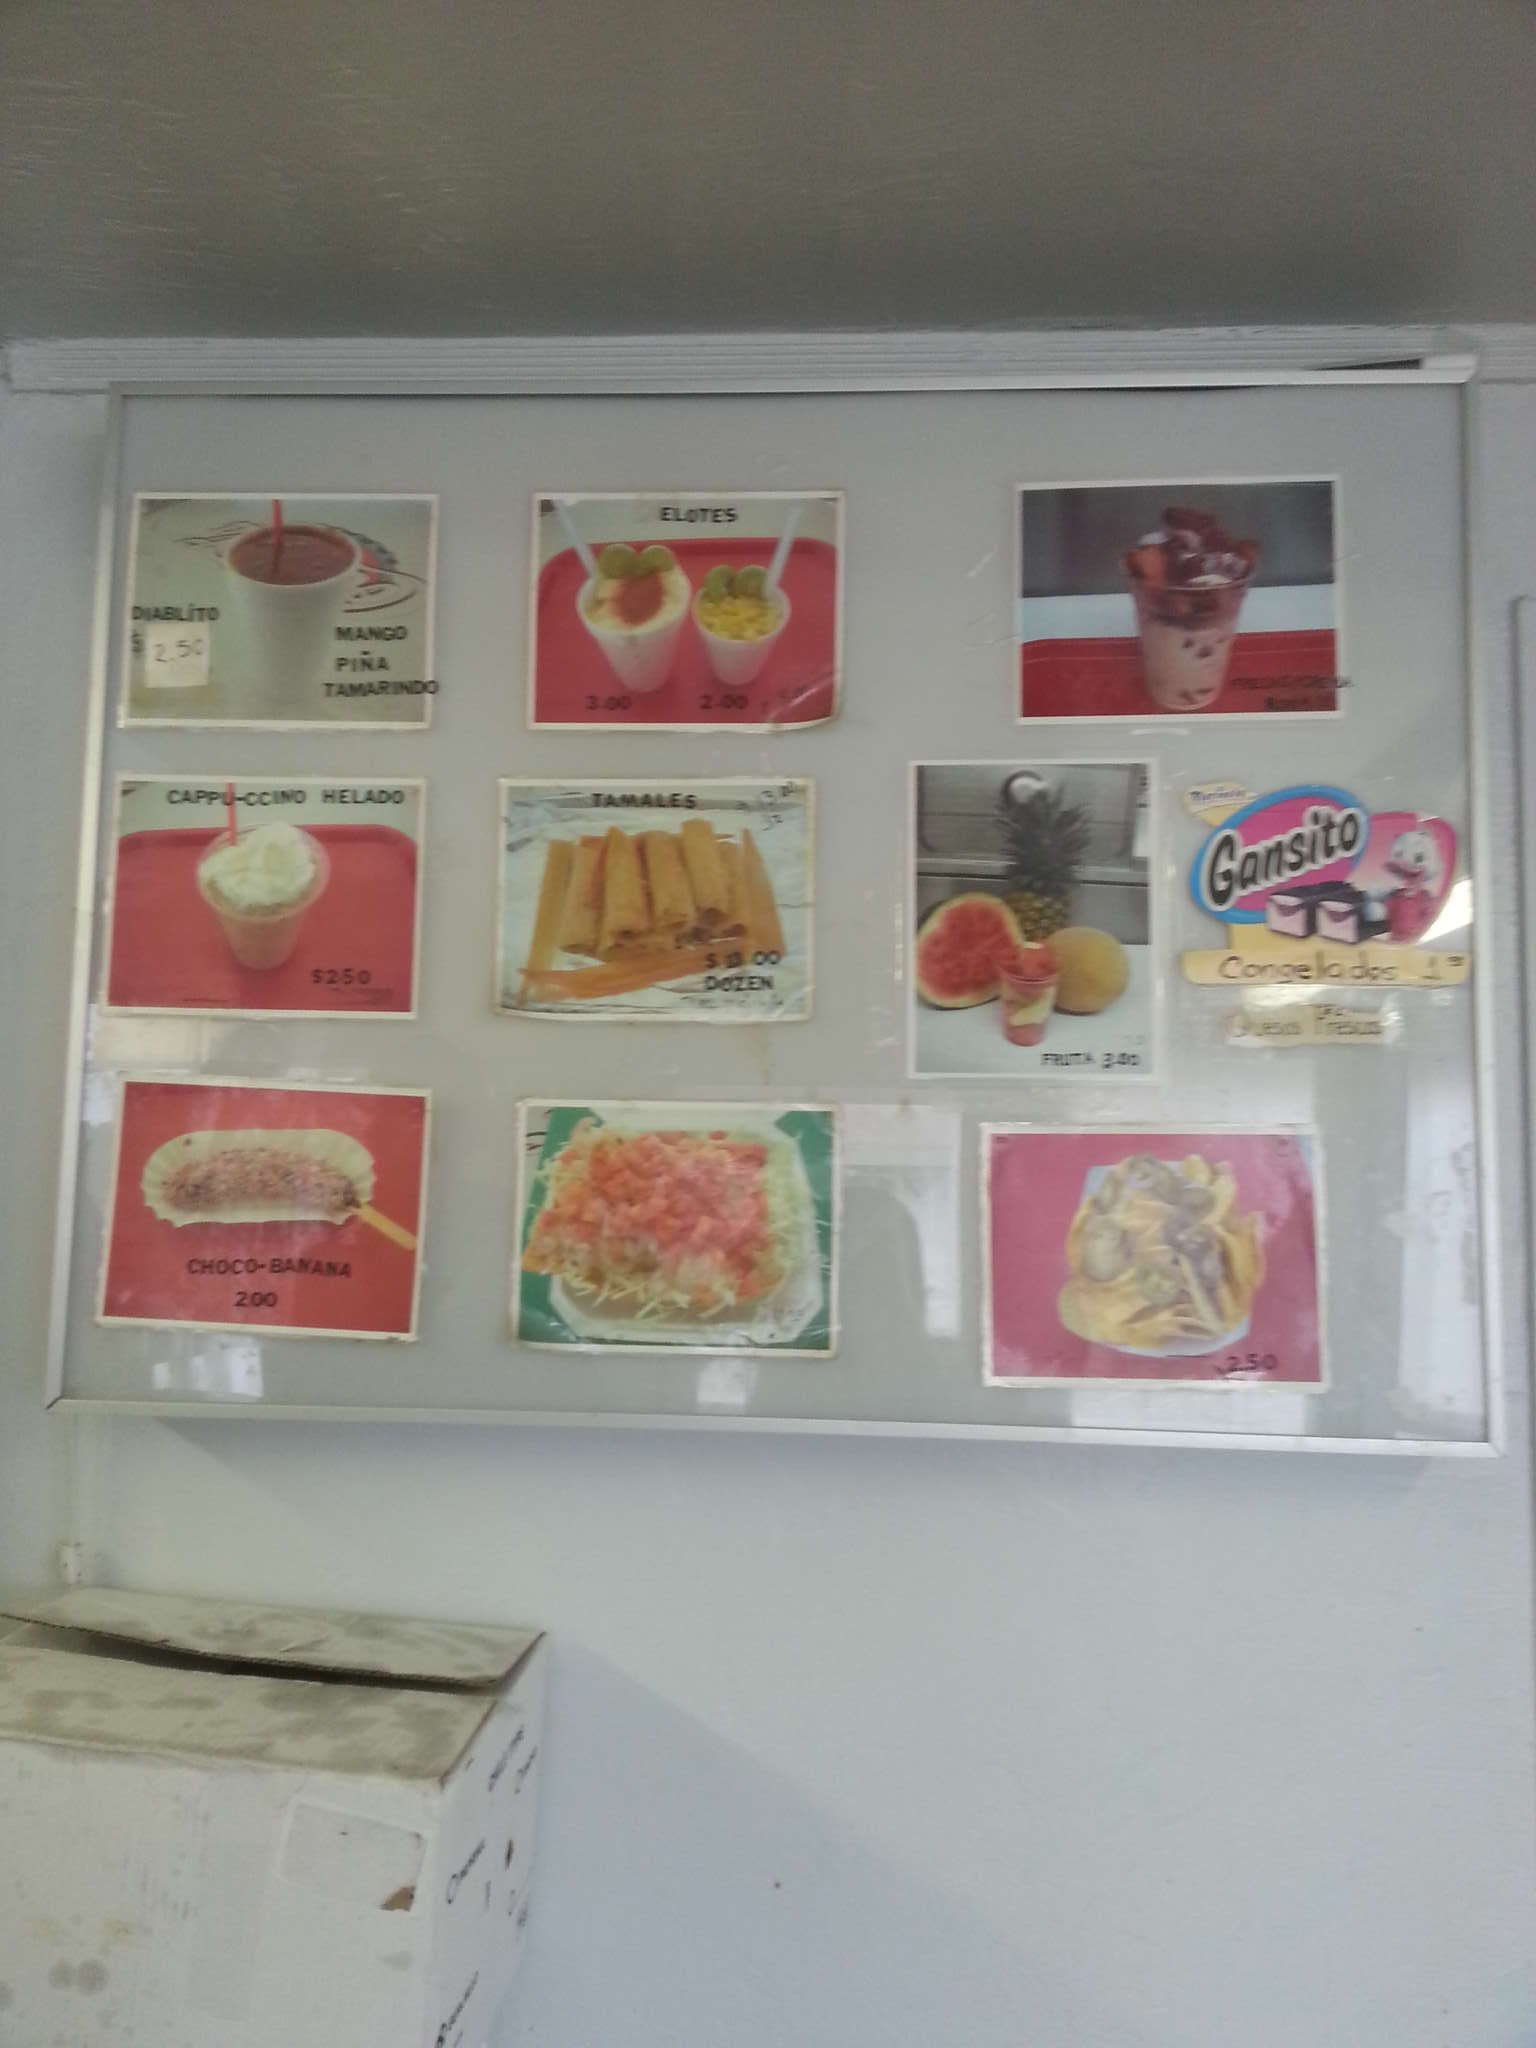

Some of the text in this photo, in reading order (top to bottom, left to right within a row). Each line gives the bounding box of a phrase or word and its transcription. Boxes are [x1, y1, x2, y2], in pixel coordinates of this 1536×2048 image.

[660, 506, 738, 523] ELOTES
[336, 626, 408, 642] MANGO
[336, 650, 390, 673] PIÑA
[323, 680, 439, 698] TAMARINDO
[321, 789, 406, 805] HELADO
[592, 793, 698, 809] TAMALES
[1206, 807, 1364, 909] Gansito
[704, 975, 775, 993] DOZEN
